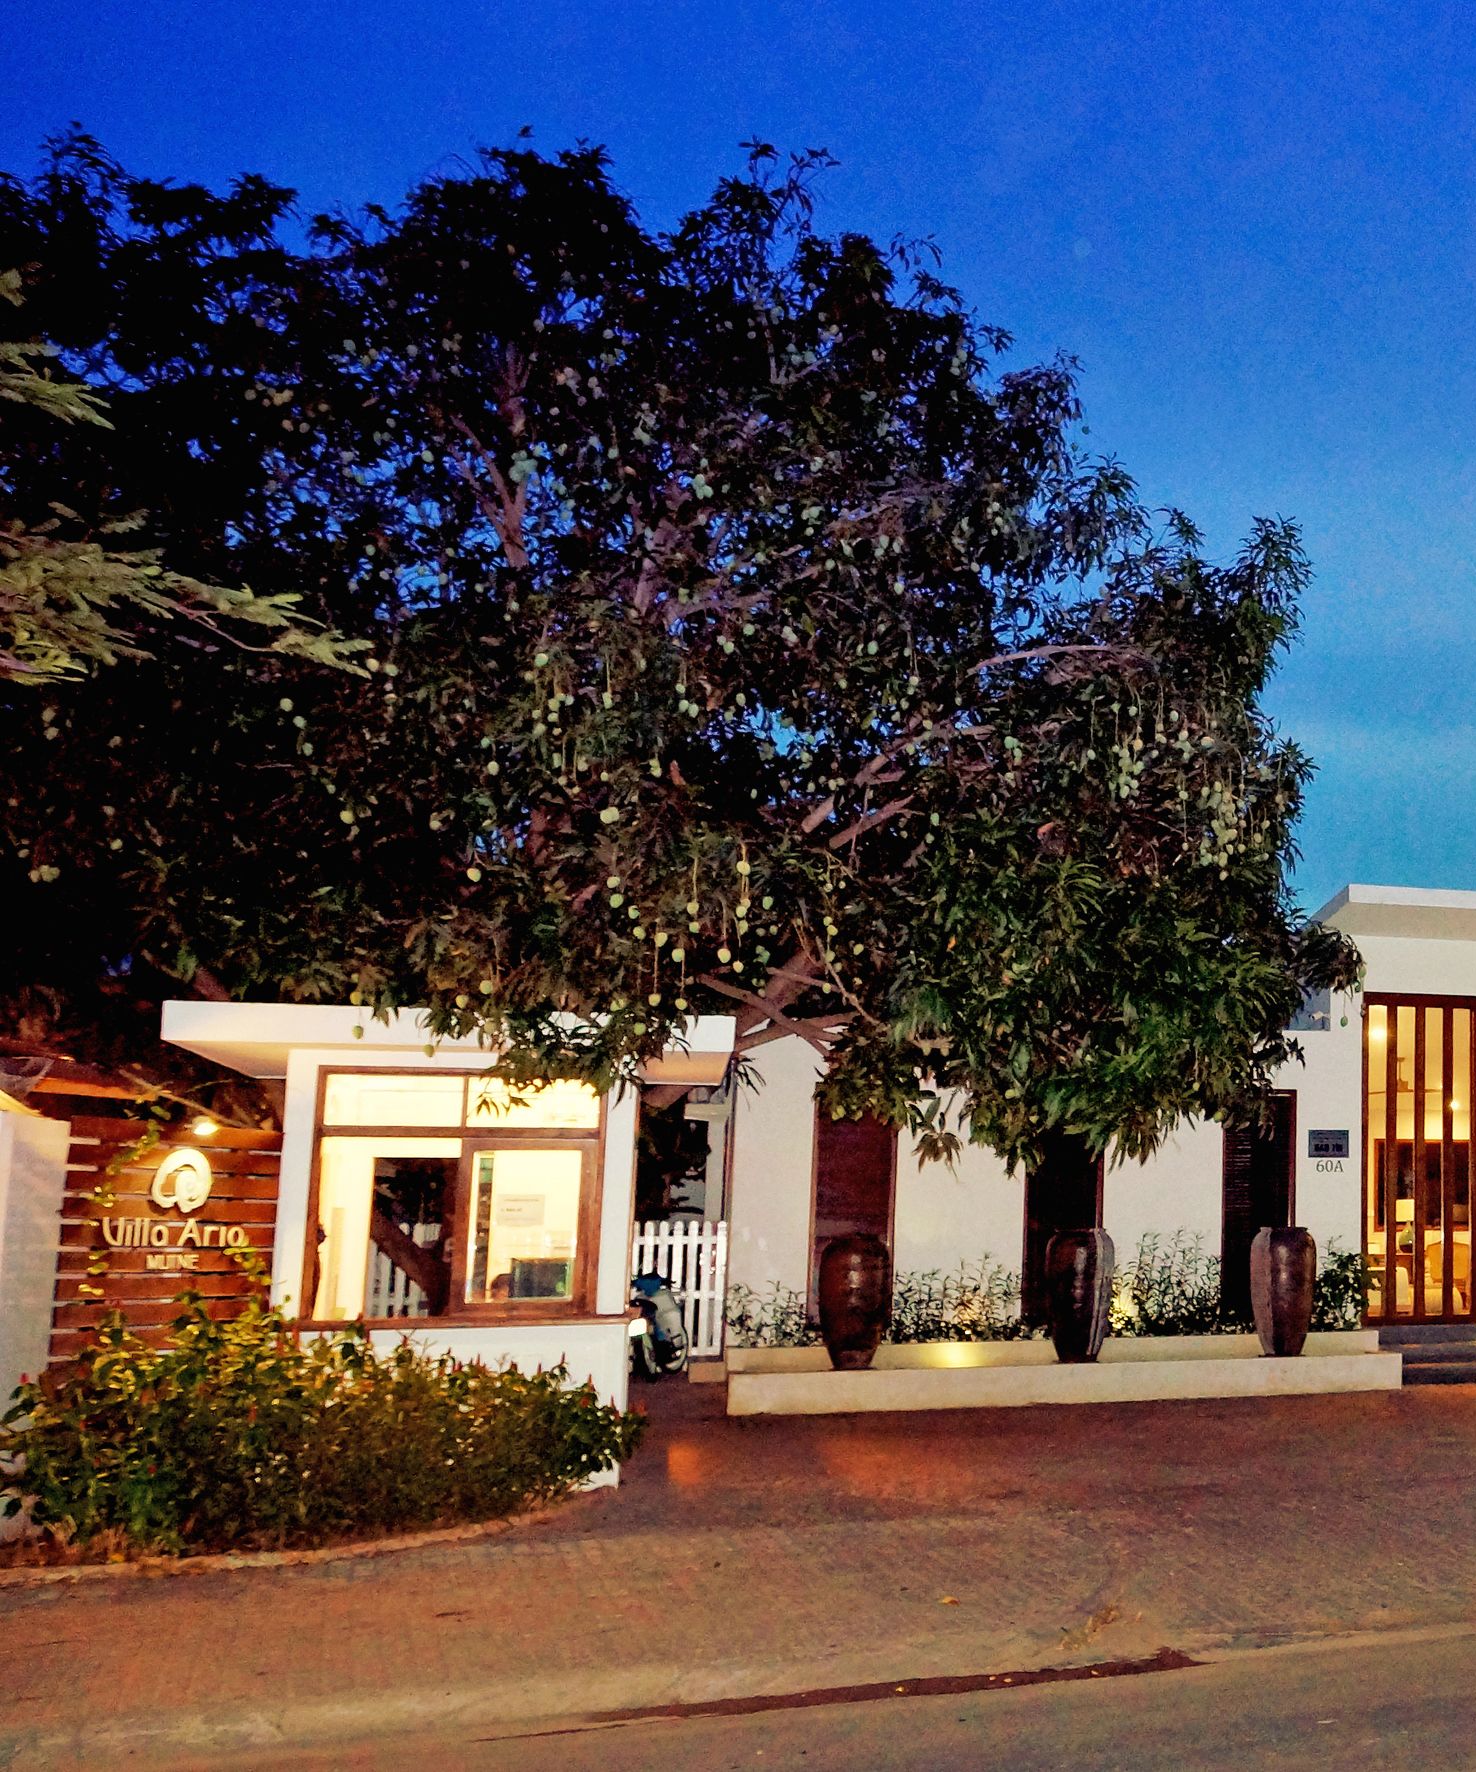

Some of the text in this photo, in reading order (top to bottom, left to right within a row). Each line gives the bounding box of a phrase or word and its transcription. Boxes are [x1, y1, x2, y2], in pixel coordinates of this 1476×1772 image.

[1316, 1159, 1344, 1173] 60A
[102, 1216, 248, 1248] Villa Aria
